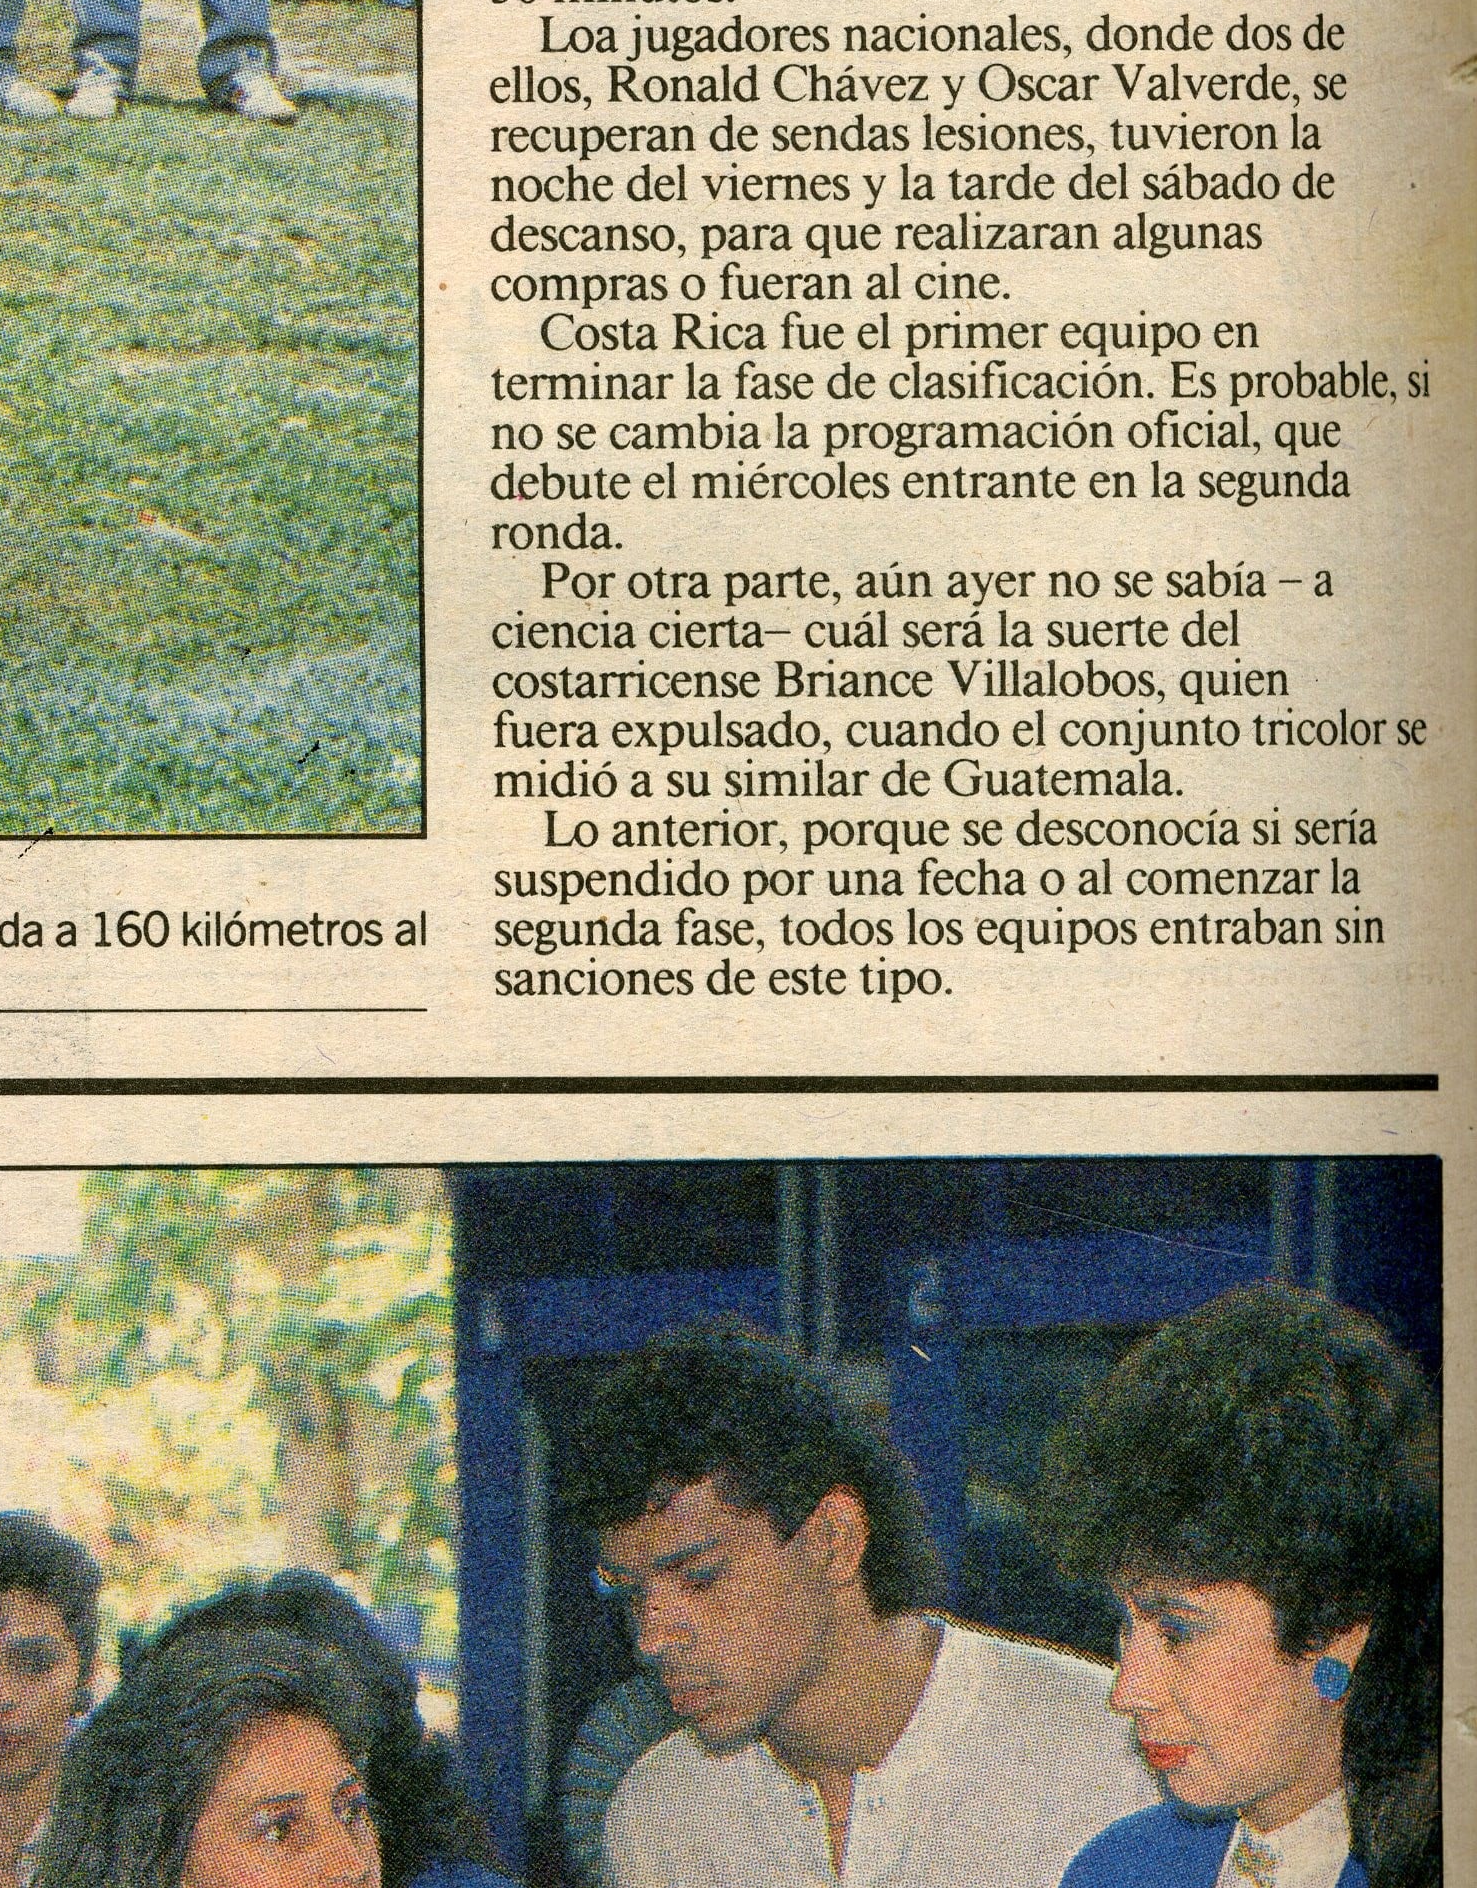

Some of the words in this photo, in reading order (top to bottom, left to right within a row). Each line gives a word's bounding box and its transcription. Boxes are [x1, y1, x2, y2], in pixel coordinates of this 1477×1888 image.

[490, 66, 591, 110] ellos,
[608, 64, 760, 102] Ronald
[774, 64, 928, 102] Chávez
[942, 76, 965, 110] y
[979, 64, 1099, 101] Oscar
[1112, 63, 1299, 107] Valverde,
[1314, 74, 1346, 100] se
[493, 660, 760, 698] costarricense
[776, 659, 932, 697] Briance
[948, 660, 1165, 703] Villalobos,
[1180, 658, 1289, 704] quien
[56, 921, 76, 947] a
[95, 911, 169, 947] 160
[183, 911, 383, 946] kilómetros
[395, 911, 426, 946] al
[495, 958, 693, 995] sanciones
[707, 958, 755, 995] de
[769, 964, 846, 995] este
[860, 957, 952, 1003] tipo.
